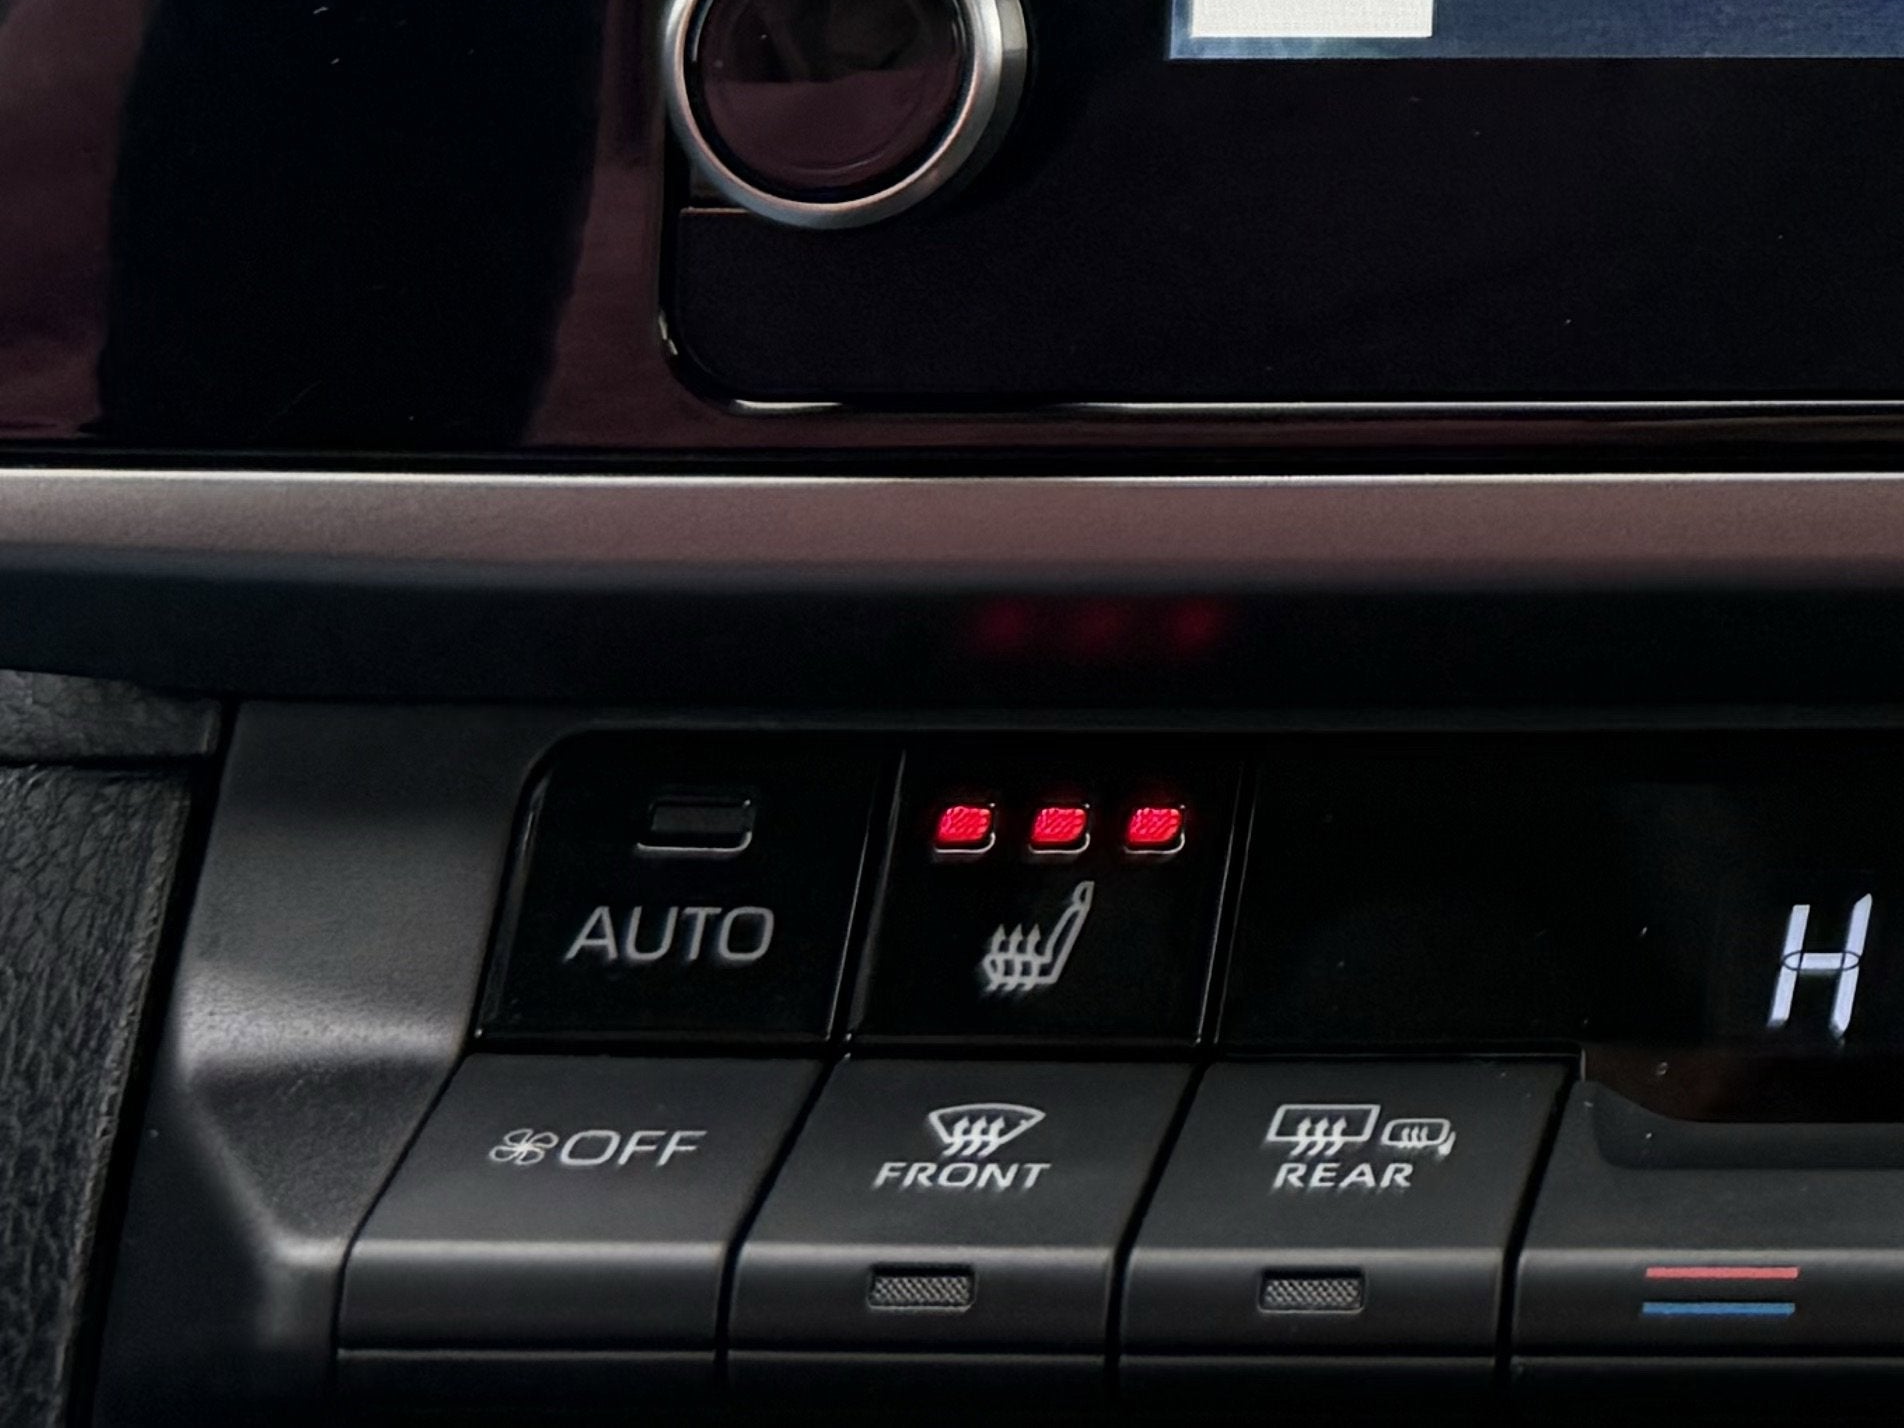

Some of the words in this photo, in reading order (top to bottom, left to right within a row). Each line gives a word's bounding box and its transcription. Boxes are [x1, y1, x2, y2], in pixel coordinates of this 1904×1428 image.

[563, 905, 775, 962] AUTO
[561, 1129, 706, 1167] OFF
[873, 1161, 1051, 1190] FRONT
[1273, 1161, 1413, 1190] REAR
